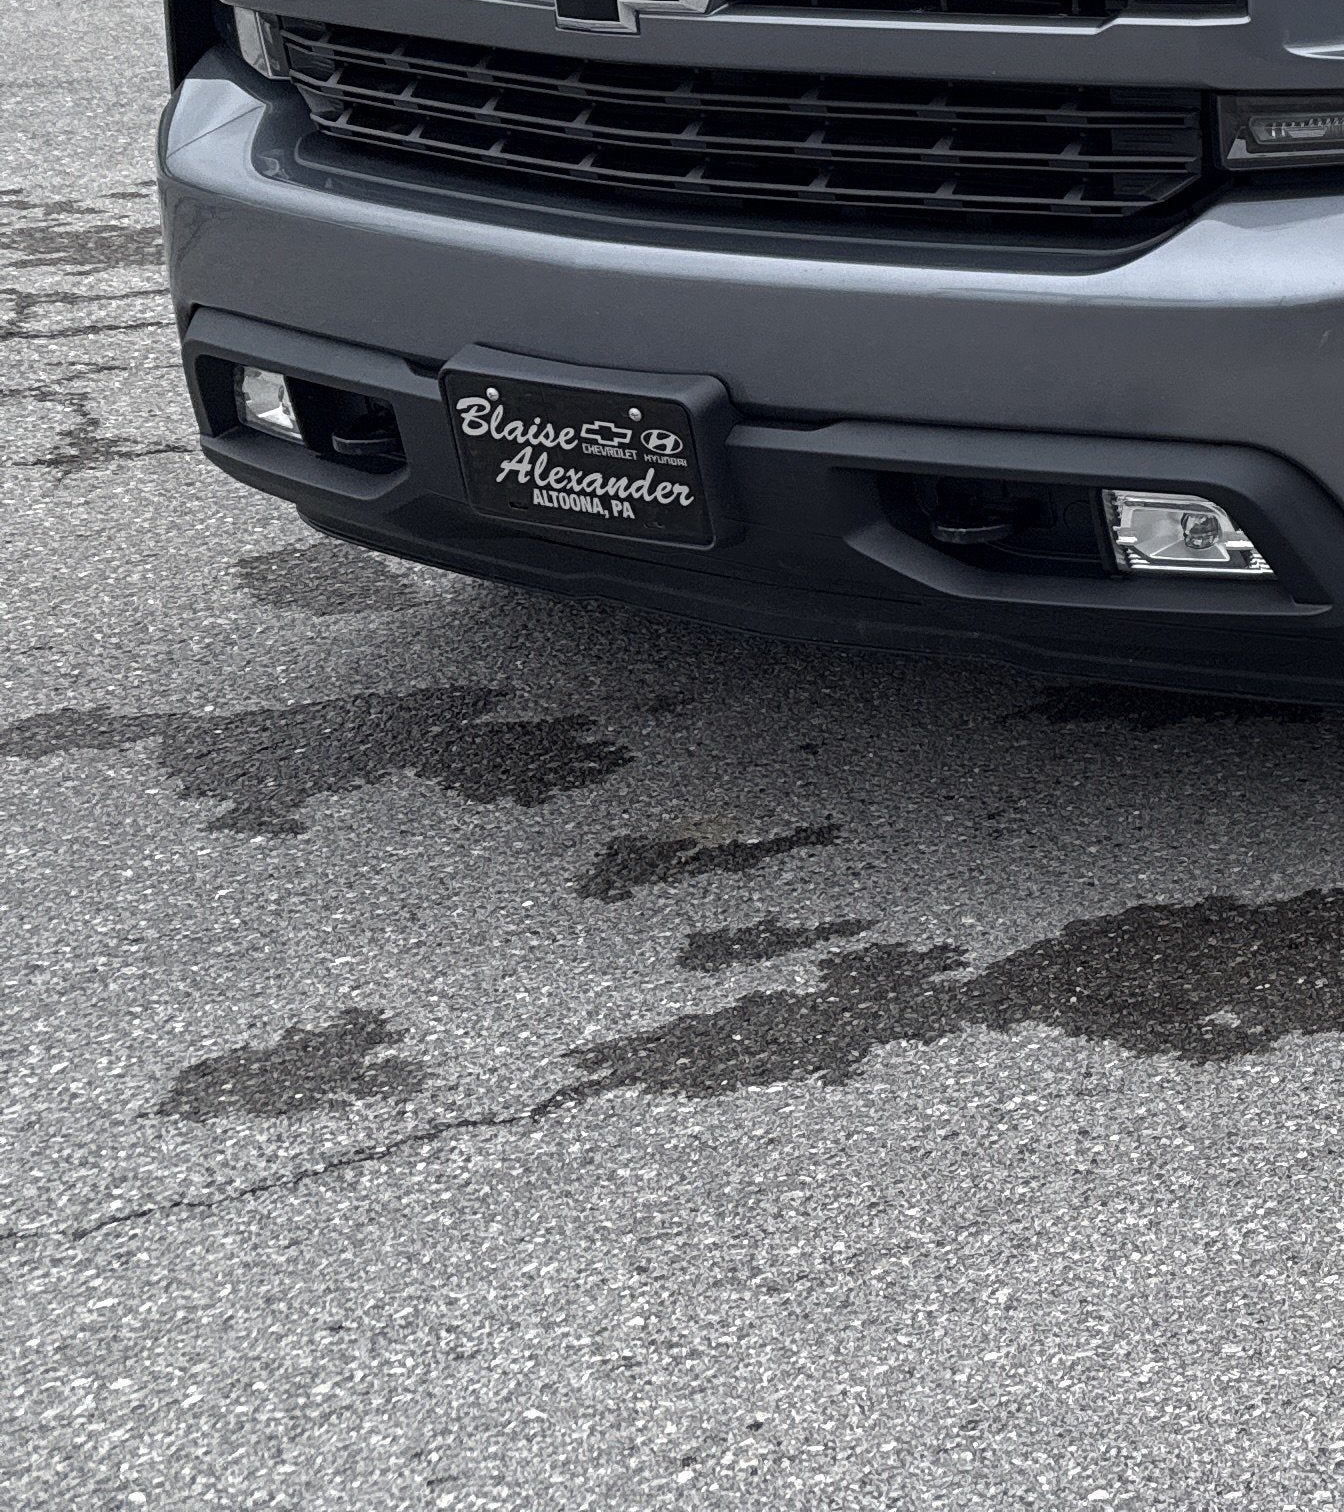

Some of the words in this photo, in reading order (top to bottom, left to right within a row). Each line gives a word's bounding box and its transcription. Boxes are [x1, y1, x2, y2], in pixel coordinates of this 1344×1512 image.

[456, 397, 578, 450] Blaise
[582, 443, 638, 461] CHEVROLET
[643, 453, 688, 467] HYUNDAI
[496, 446, 695, 507] Alexander
[533, 488, 610, 519] ALTOONA,
[612, 500, 636, 519] PA
